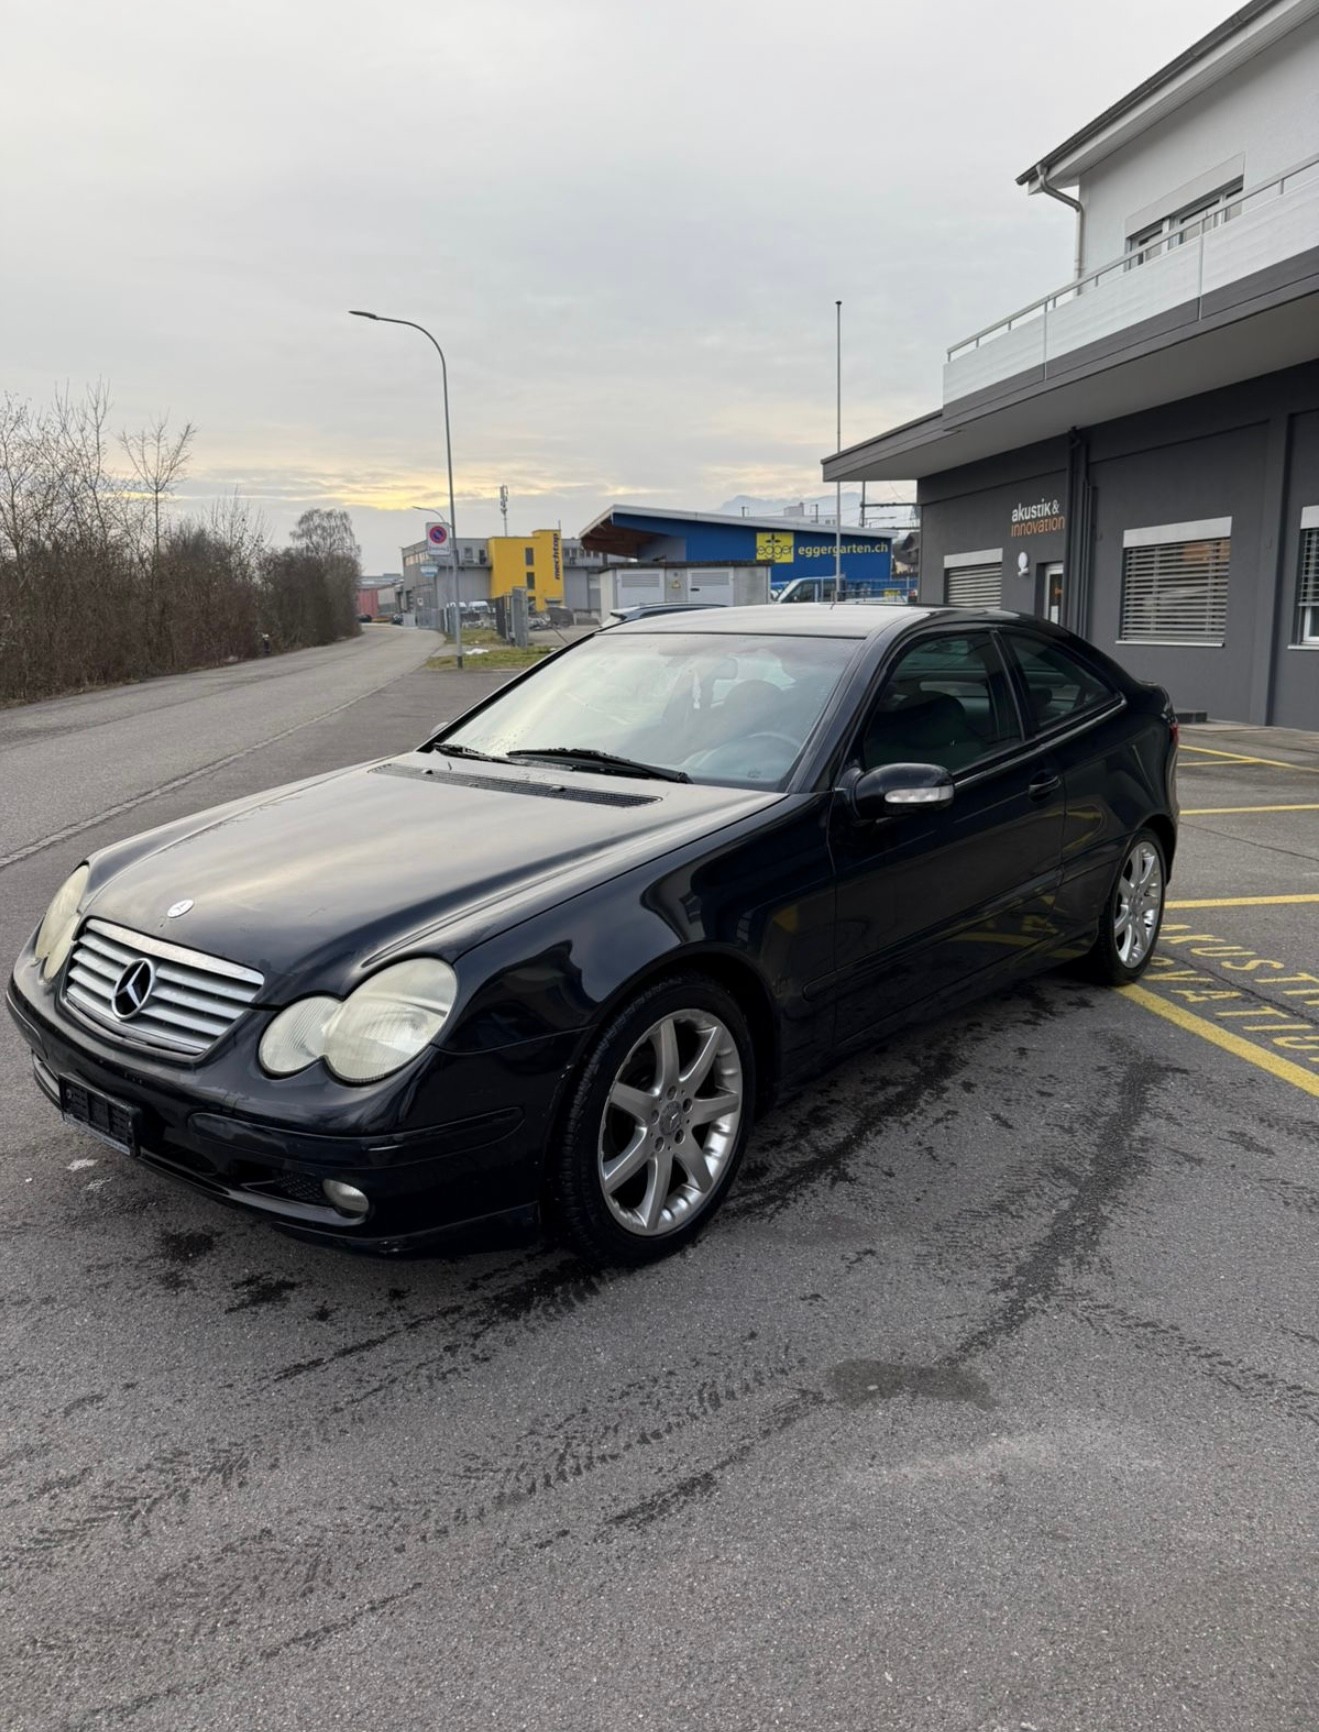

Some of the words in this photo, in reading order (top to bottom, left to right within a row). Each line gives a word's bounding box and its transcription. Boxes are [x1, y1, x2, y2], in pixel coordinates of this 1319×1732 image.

[1011, 498, 1051, 522] akustik
[1052, 499, 1060, 515] &
[1010, 516, 1066, 537] innovation
